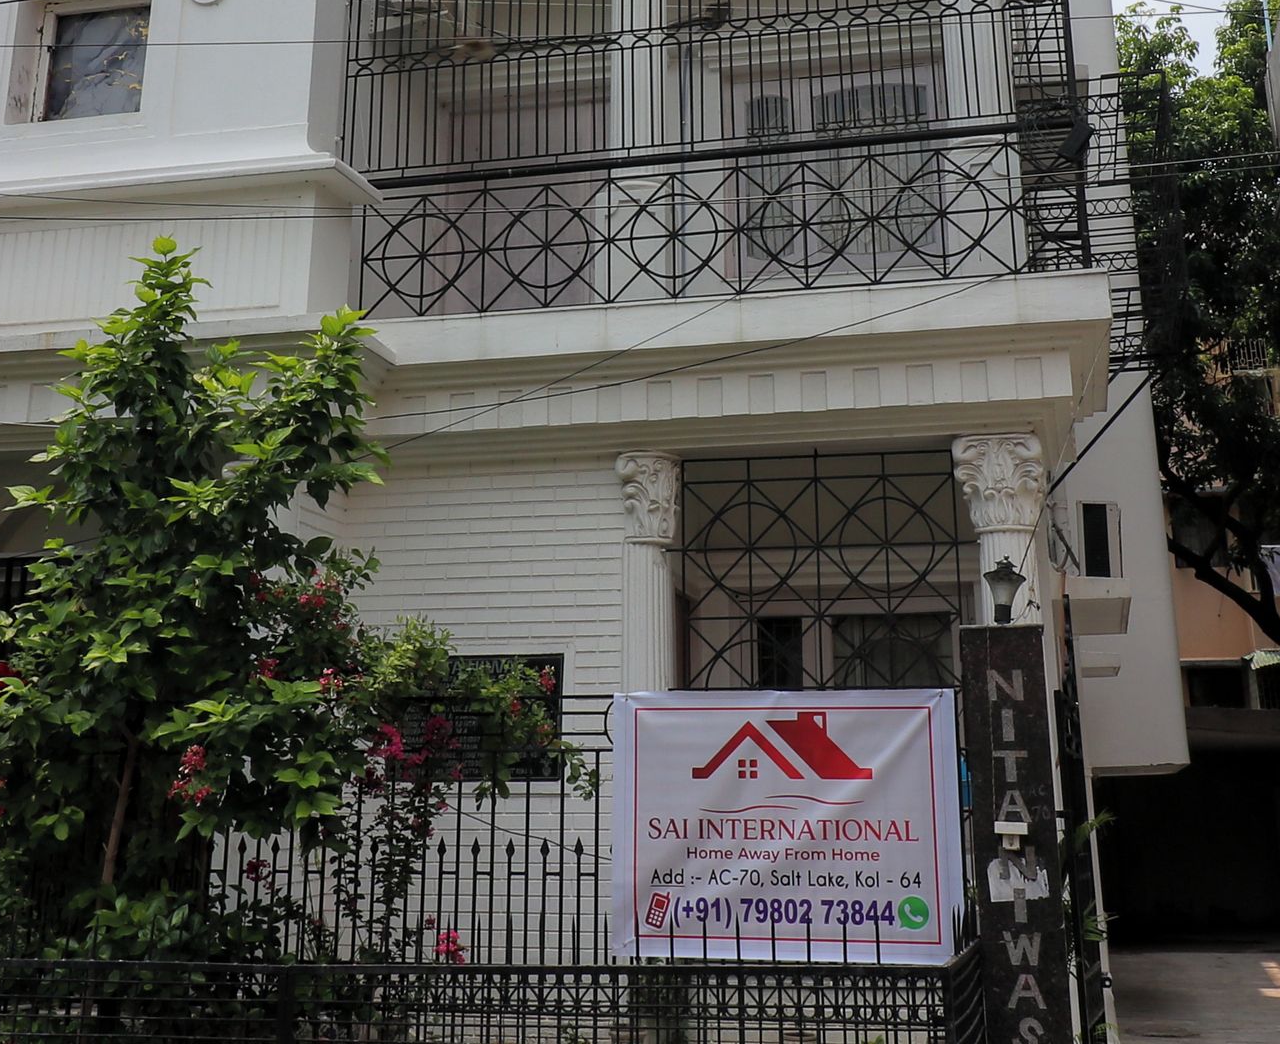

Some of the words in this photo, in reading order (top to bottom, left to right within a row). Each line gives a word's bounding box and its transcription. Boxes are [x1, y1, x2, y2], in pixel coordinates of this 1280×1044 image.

[986, 669, 1032, 823] NITA
[647, 818, 689, 840] SAI
[698, 818, 920, 843] INTERNATIONAL
[686, 847, 733, 860] Home
[737, 848, 779, 863] Away
[785, 848, 827, 861] From
[832, 848, 880, 862] Home
[650, 868, 685, 886] Add
[708, 869, 764, 888] AC-70,
[770, 869, 802, 887] Salt
[807, 870, 849, 889] Lake,
[856, 870, 880, 888] Kol
[899, 873, 922, 888] 64
[673, 896, 733, 929] (+91)
[740, 898, 813, 924] 79802
[820, 899, 895, 926] 73844
[998, 845, 1048, 1044] NIWAS
